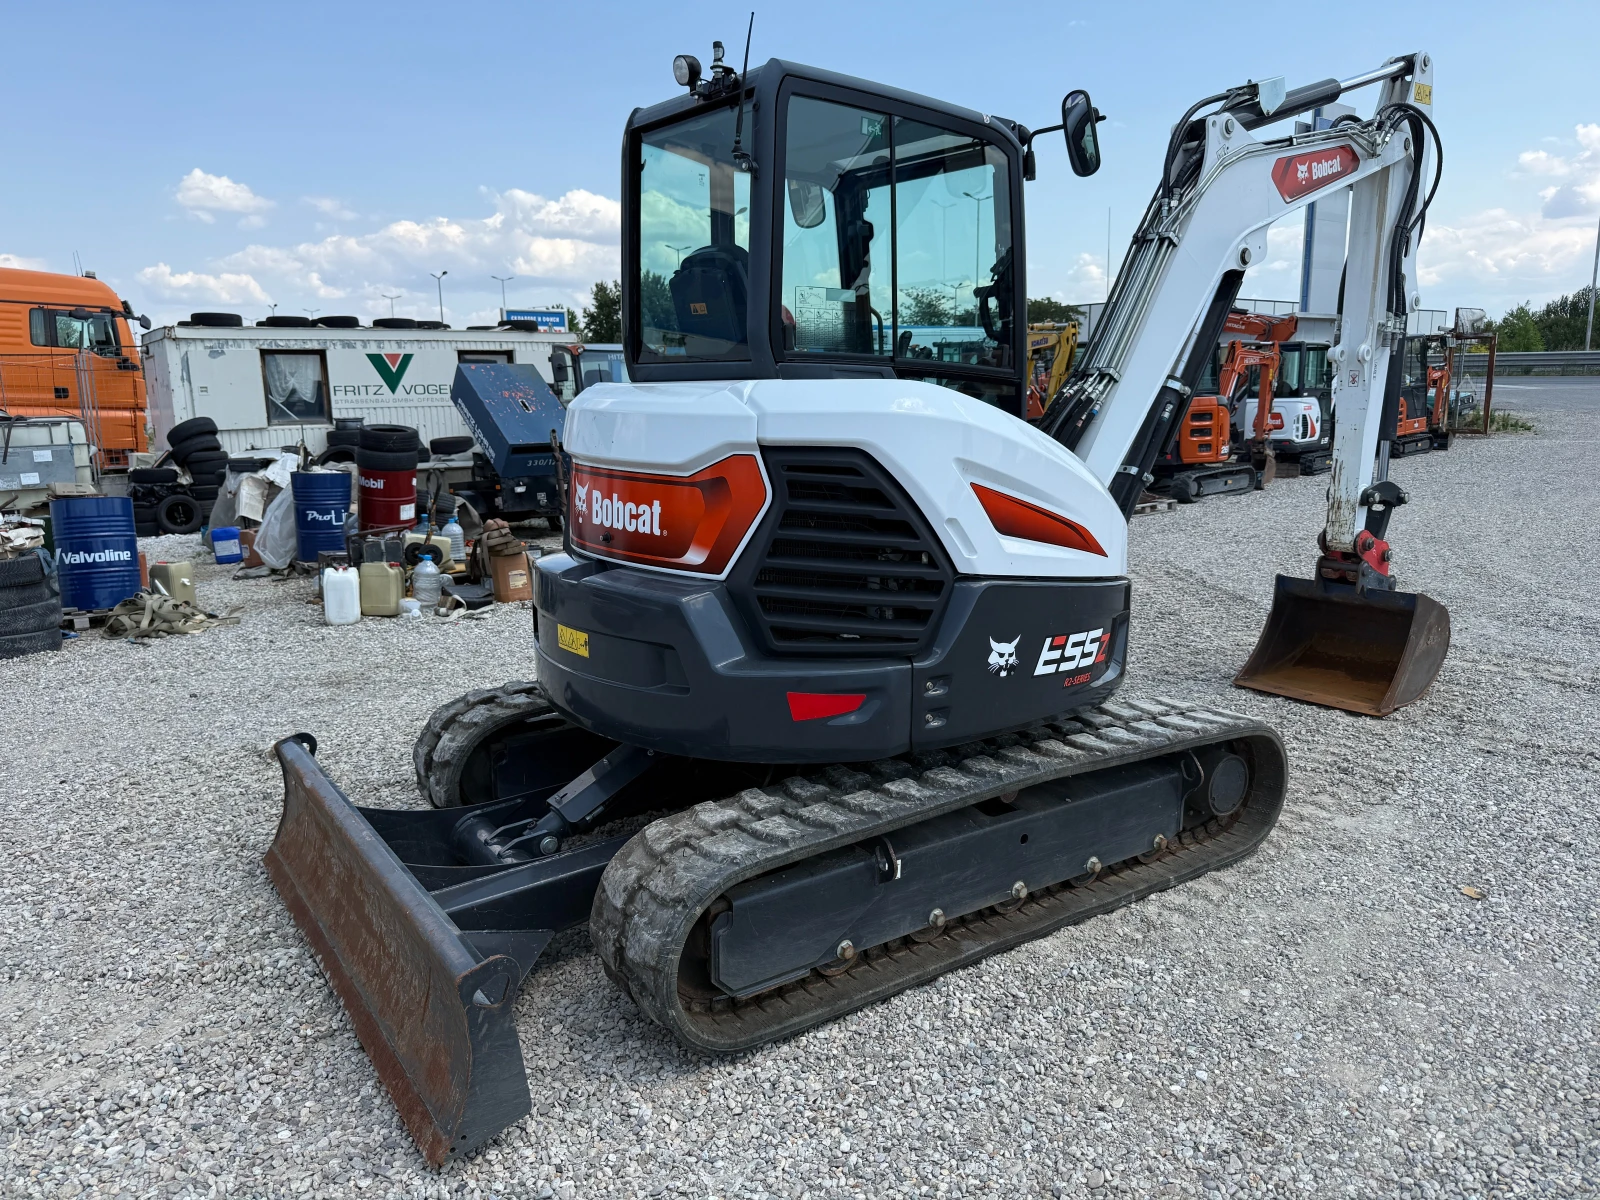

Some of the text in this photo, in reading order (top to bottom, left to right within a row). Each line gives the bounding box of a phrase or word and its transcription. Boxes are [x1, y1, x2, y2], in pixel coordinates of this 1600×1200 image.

[1311, 154, 1341, 181] Bobcat
[1226, 322, 1246, 330] HITACHI
[333, 384, 385, 397] FRITZ
[334, 397, 390, 405] STRASSENBAU
[358, 475, 384, 489] Mobil
[592, 489, 662, 536] Bobcat
[61, 549, 131, 565] Valvoline
[1063, 672, 1092, 687] R2-SERIES
